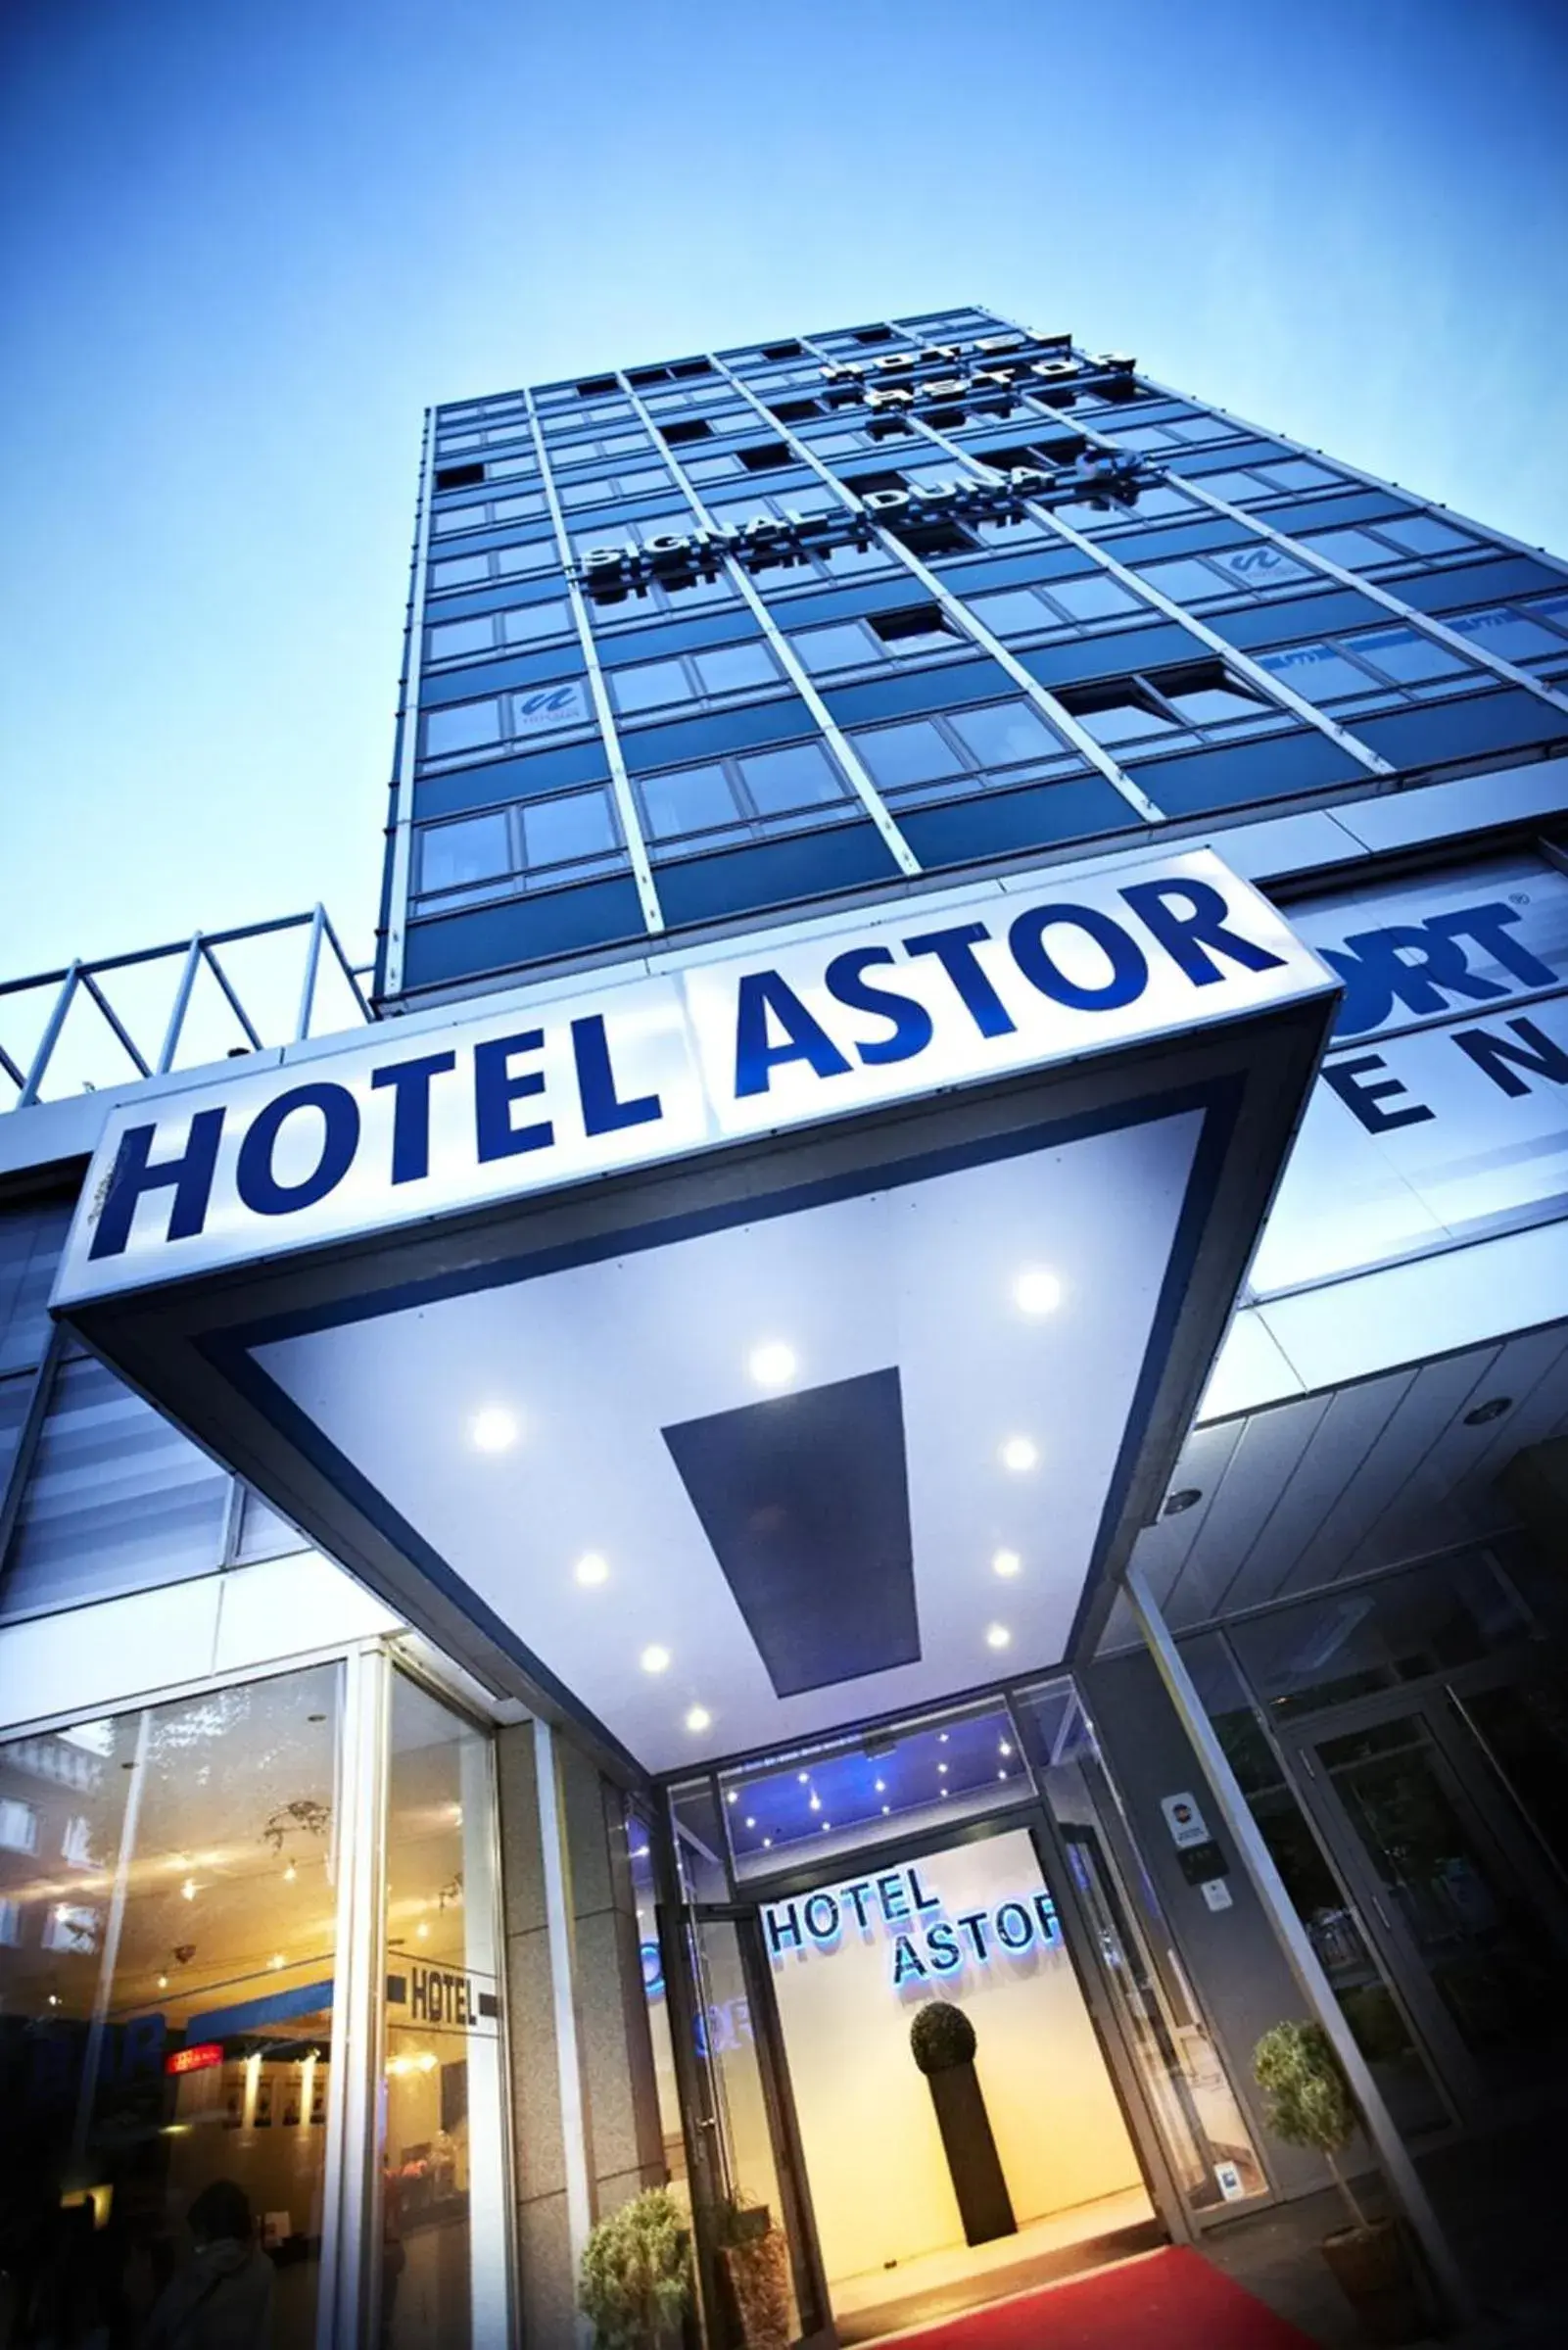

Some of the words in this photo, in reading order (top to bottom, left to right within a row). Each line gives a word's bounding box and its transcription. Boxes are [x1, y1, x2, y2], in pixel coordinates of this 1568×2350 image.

[819, 329, 1073, 382] HOTEL
[863, 351, 1137, 407] ASTOR
[580, 507, 829, 572] SIGNAL
[87, 1016, 662, 1263] HOTEL
[733, 878, 1289, 1100] ASTOR
[766, 1868, 940, 1952] HOTEL
[411, 1966, 477, 2026] HOTEL
